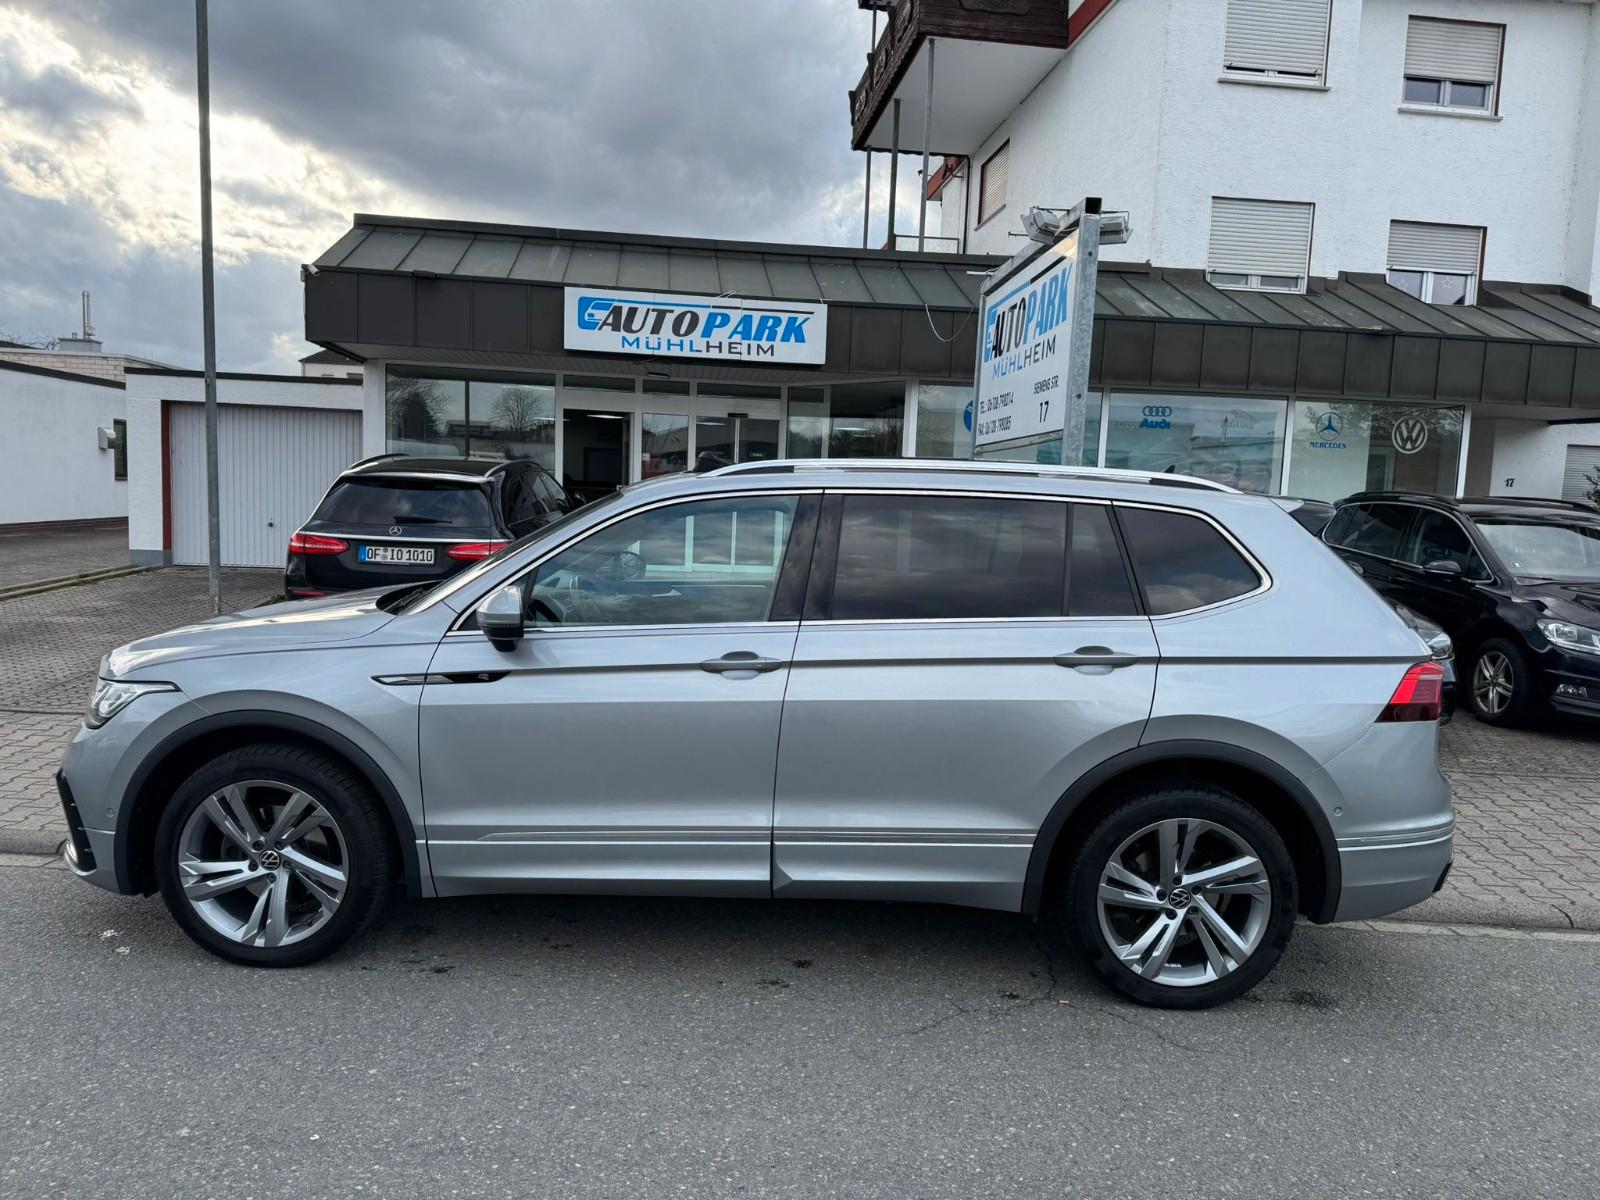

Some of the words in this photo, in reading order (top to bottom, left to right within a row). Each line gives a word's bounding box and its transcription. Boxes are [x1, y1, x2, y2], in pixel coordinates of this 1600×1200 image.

[990, 263, 1073, 360] AUTOPARK
[598, 305, 811, 343] AUTOPARK
[992, 334, 1056, 380] MÜHLHEIM
[1039, 400, 1049, 423] 17
[1139, 418, 1171, 429] Audi
[1504, 477, 1516, 488] 17
[367, 547, 381, 560] OF
[406, 548, 433, 562] 1010
